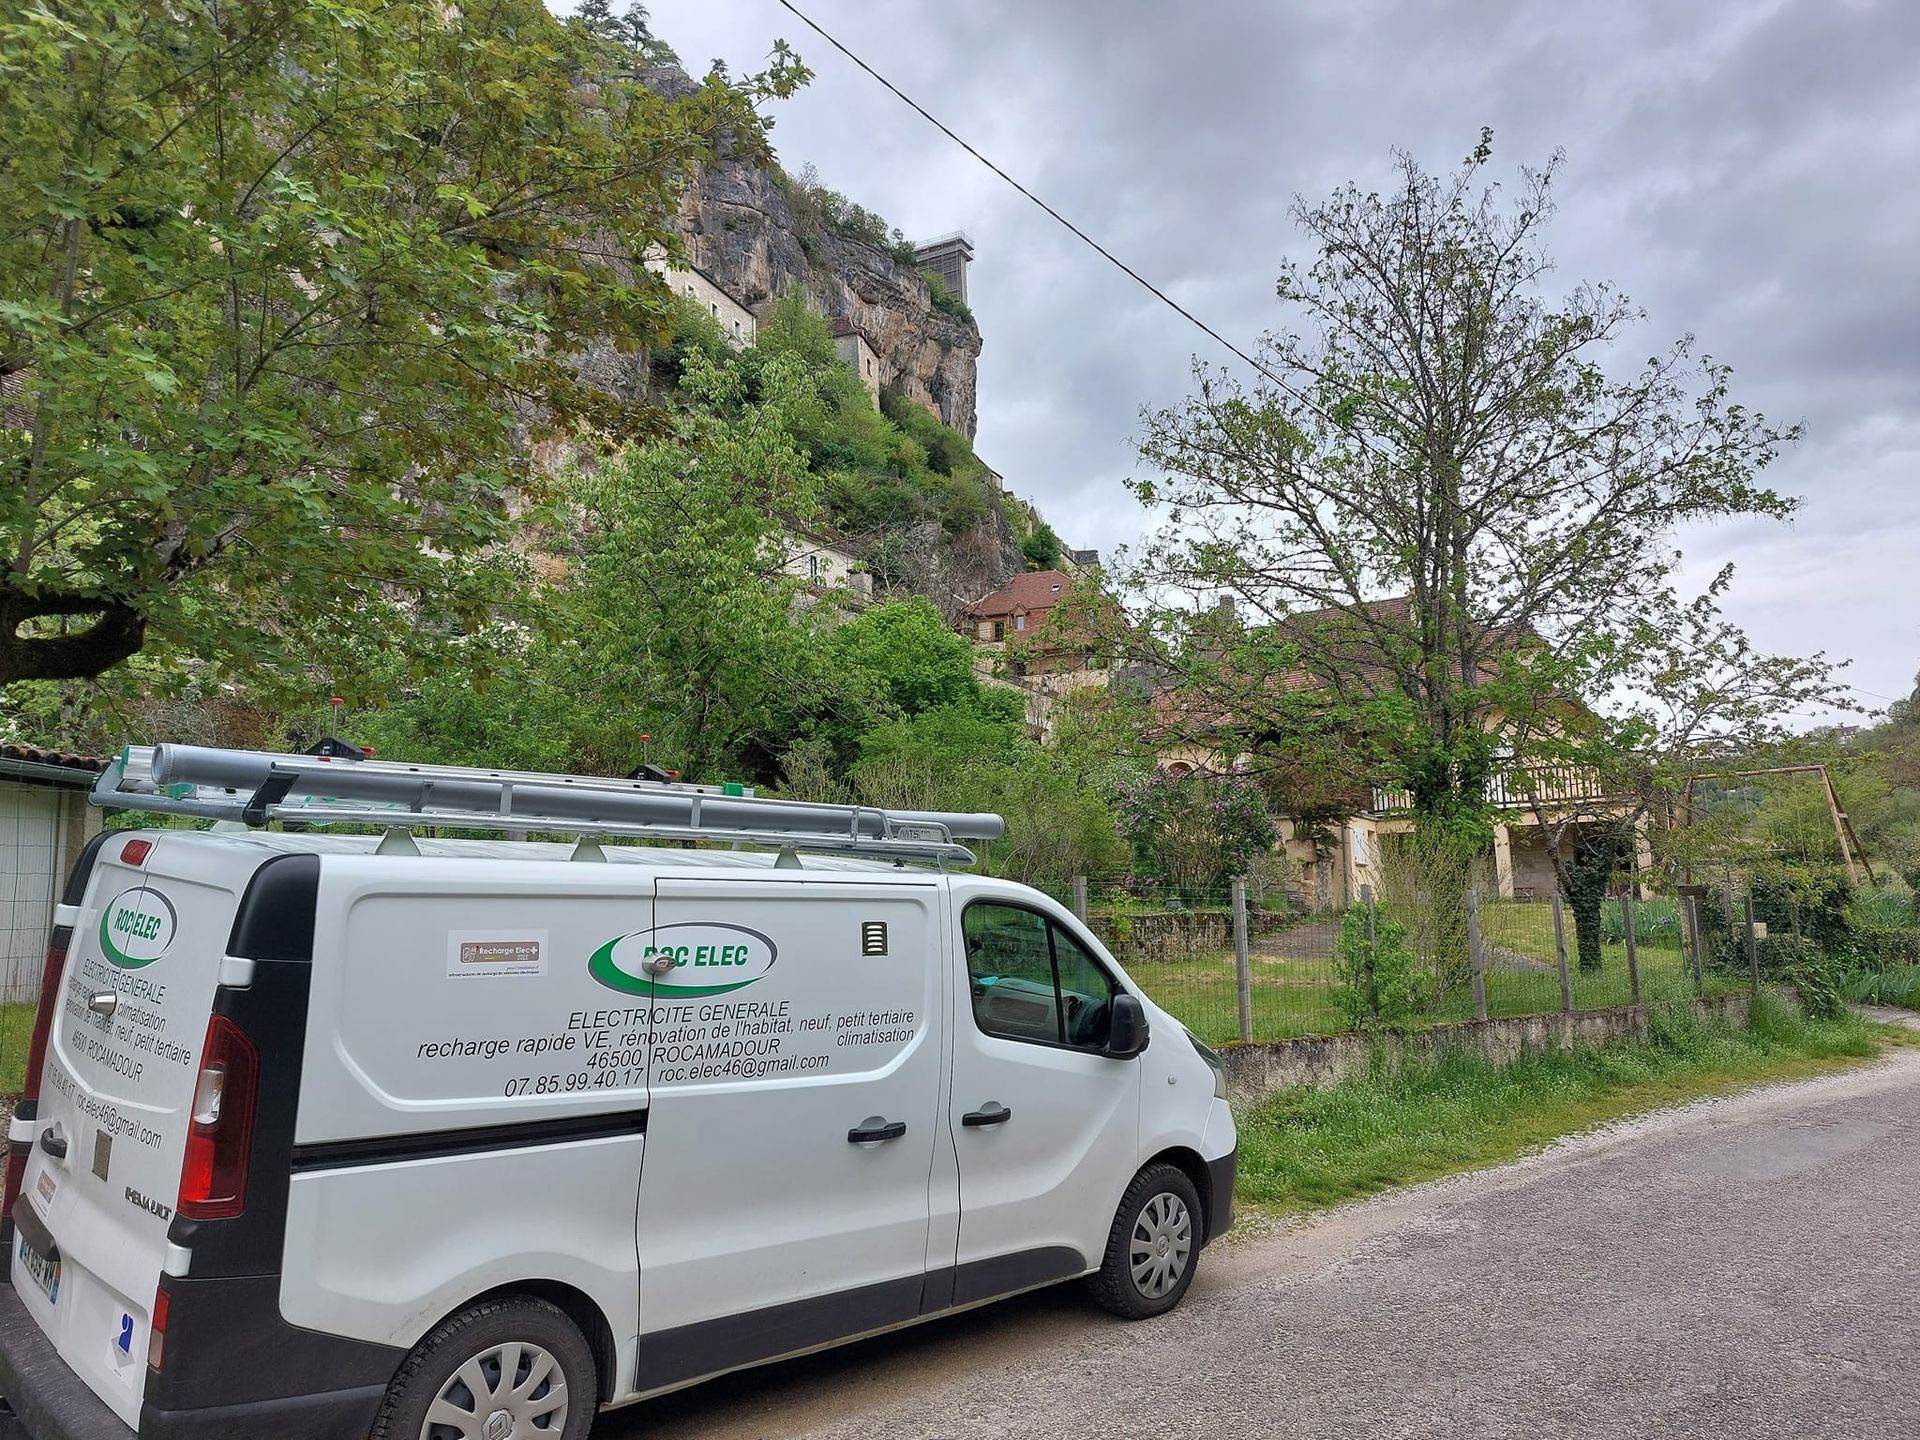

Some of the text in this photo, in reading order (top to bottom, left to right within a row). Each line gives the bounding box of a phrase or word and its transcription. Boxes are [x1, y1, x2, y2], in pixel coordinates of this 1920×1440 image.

[114, 908, 162, 941] ROC ELEC
[694, 945, 749, 967] ELEC
[82, 958, 121, 990] ELECTRICITE
[118, 974, 167, 1005] GENERALE
[117, 1002, 166, 1033] climatisation
[568, 1001, 790, 1030] ELECTRICITE GENERALE
[134, 1031, 155, 1053] petit
[154, 1036, 191, 1066] tertiaire
[417, 1009, 914, 1060] recharge rapide VE, rénovation de l'habitat, neuf, petit tertiaire
[836, 1026, 914, 1047] climatisation
[88, 1039, 144, 1083] ROCAMADOUR
[586, 1038, 781, 1070] 46500 ROCAMADOUR
[504, 1053, 829, 1098] 07.85.99.40.17 roc.elec46@gmail.com
[125, 1186, 172, 1222] RENAULT
